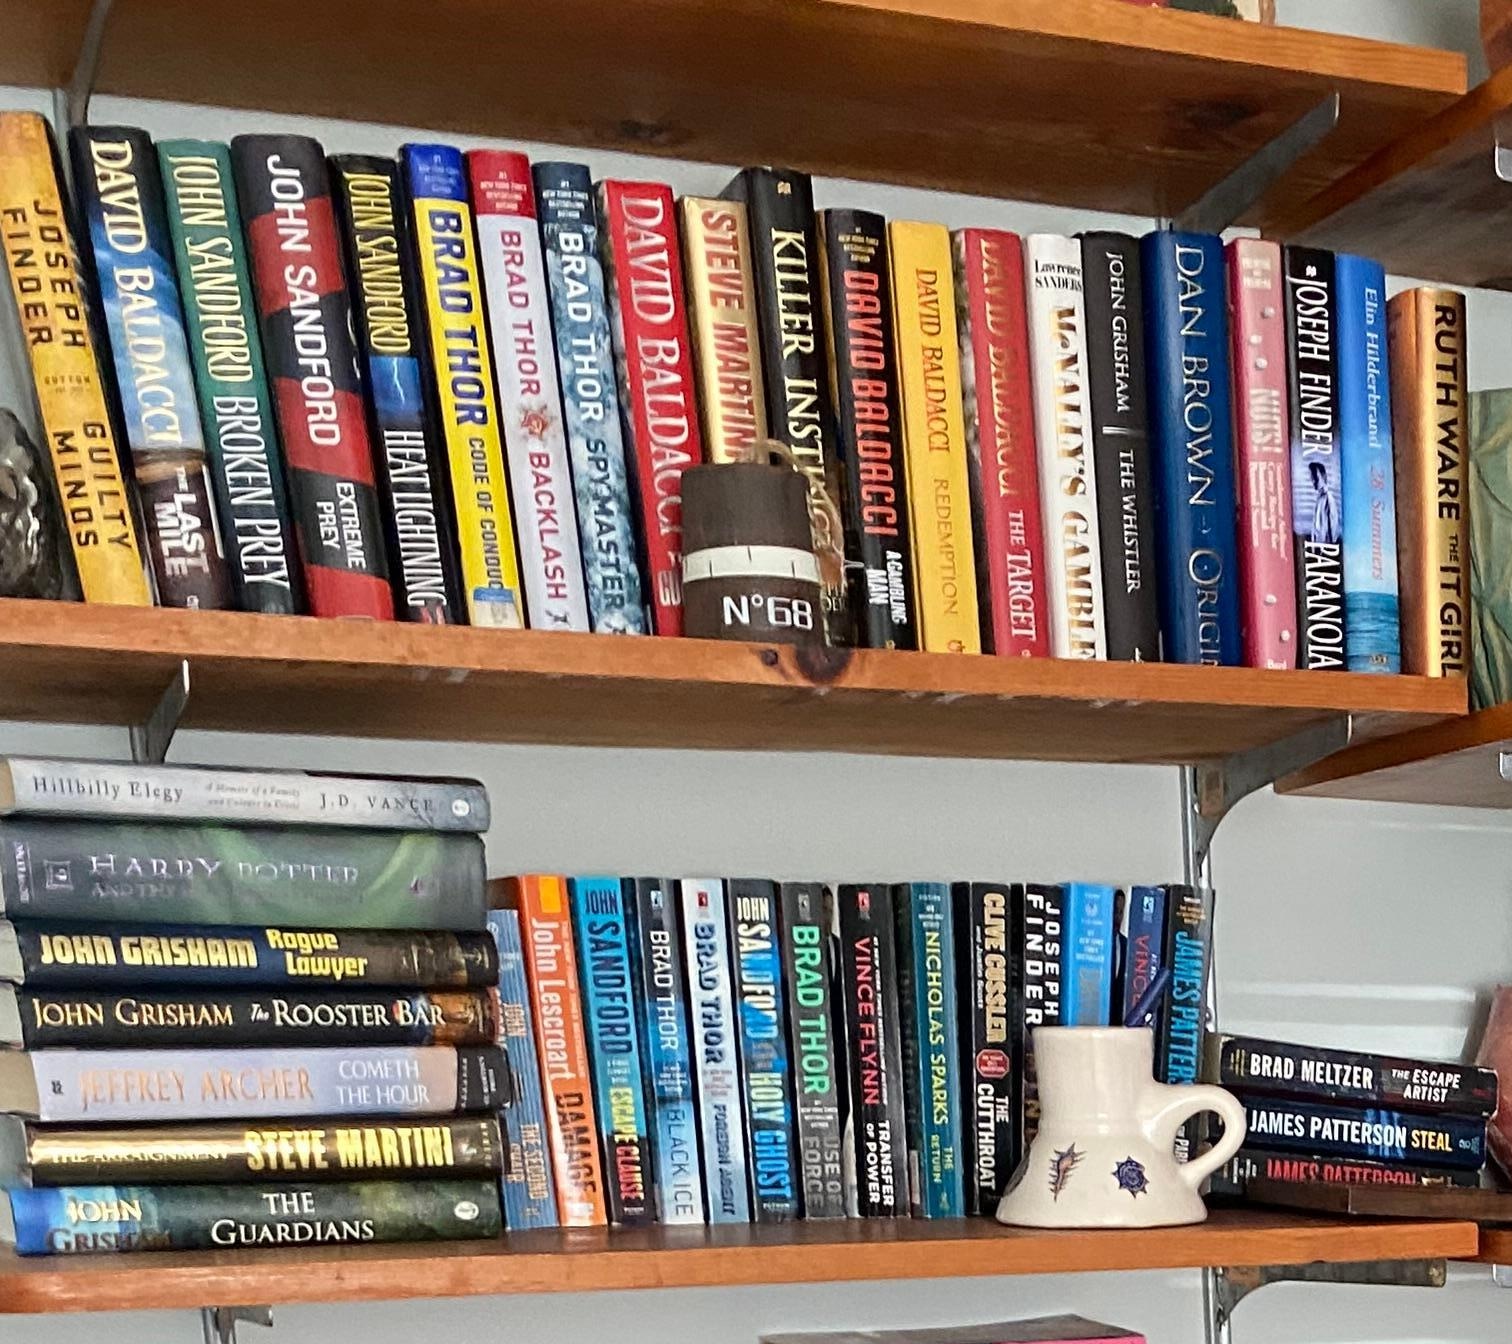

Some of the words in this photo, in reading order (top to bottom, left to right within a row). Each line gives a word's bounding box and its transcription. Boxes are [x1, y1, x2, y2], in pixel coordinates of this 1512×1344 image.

[89, 139, 145, 254] DAVID
[167, 155, 227, 228] JOHN
[268, 154, 311, 252] JOHN
[2, 208, 53, 346] FINDER
[34, 201, 86, 349] JOSEPH
[500, 229, 530, 308] BRAD
[558, 230, 592, 323] BRAD
[916, 269, 940, 337] DAVID
[1106, 251, 1125, 307] JOHN
[1176, 243, 1206, 337] DAN
[186, 236, 254, 383] SANDFORD
[842, 270, 884, 367] DAVID
[1287, 276, 1330, 360] JOSEPH
[112, 266, 183, 447] BALDACCI
[283, 265, 341, 447] SANDFORD
[511, 319, 542, 396] THOR
[570, 333, 604, 422] THOR
[1110, 316, 1131, 413] GRISHAM
[1434, 303, 1458, 407] RUTH
[923, 344, 949, 454] BALDACCI
[1182, 354, 1215, 506] BROWN
[1301, 371, 1333, 458] FINDER
[53, 431, 98, 547] MINDS
[82, 421, 132, 550] GUILTY
[212, 395, 274, 506] BROKEN
[852, 379, 898, 536] BALDACCI
[1119, 450, 1134, 489] THE
[1436, 417, 1460, 520] WARE
[233, 518, 291, 589] PREY
[316, 500, 339, 549] PREY
[335, 483, 367, 570] EXTREME
[527, 451, 569, 599] BACKLASH
[585, 438, 626, 610] SPYMASTER
[934, 479, 959, 616] REDEMPTION
[1120, 495, 1142, 593] WHISTLER
[1448, 533, 1459, 562] THE
[1303, 541, 1343, 670] PARANOIA
[1439, 564, 1461, 593] IT
[33, 776, 120, 798] Hillbilly
[130, 782, 184, 800] Elegy
[40, 934, 116, 966] JOHN
[122, 937, 258, 968] GRISHAM
[266, 929, 338, 951] Rogue
[649, 930, 673, 989] BRAD
[984, 893, 1006, 951] CLIVE
[1025, 895, 1044, 1025] FINDER
[1044, 901, 1060, 1017] JOSEPH
[286, 952, 368, 978] Lawyer
[792, 925, 821, 1007] BRAD
[854, 937, 873, 1015] VINCE
[926, 930, 944, 1046] NICHOLAS
[32, 999, 103, 1028] JOHN
[115, 1000, 233, 1027] GRISHAM
[250, 1005, 269, 1023] The
[274, 1001, 389, 1026] ROOSTER
[398, 1001, 446, 1026] BAR
[655, 996, 678, 1049] THOR
[79, 1068, 185, 1110] JEFFREY
[200, 1068, 314, 1102] ARCHER
[336, 1085, 372, 1105] THE
[376, 1086, 429, 1105] HOUR
[339, 1061, 419, 1079] COMETH
[798, 1017, 829, 1094] THOR
[858, 1023, 880, 1104] FLYNN
[931, 1053, 948, 1124] SPARKS
[1250, 1054, 1294, 1079] BRAD
[1301, 1058, 1373, 1090] MELTZER
[1392, 1069, 1410, 1081] THE
[1413, 1070, 1461, 1088] ESCAPE
[1403, 1085, 1449, 1103] ARTIST
[244, 1130, 328, 1170] STEVE
[336, 1127, 455, 1166] MARTINI
[667, 1110, 689, 1171] BLACK
[977, 1083, 995, 1189] CUTTHROAT
[996, 1095, 1008, 1123] THE
[1250, 1110, 1306, 1138] JAMES
[1310, 1116, 1408, 1149] PATTERSON
[1411, 1131, 1452, 1151] STEAL
[674, 1179, 693, 1214] ICE
[867, 1140, 880, 1204] POWER
[879, 1119, 894, 1206] TRANSFER
[211, 1219, 375, 1245] GUARDIANS
[264, 1193, 316, 1214] THE
